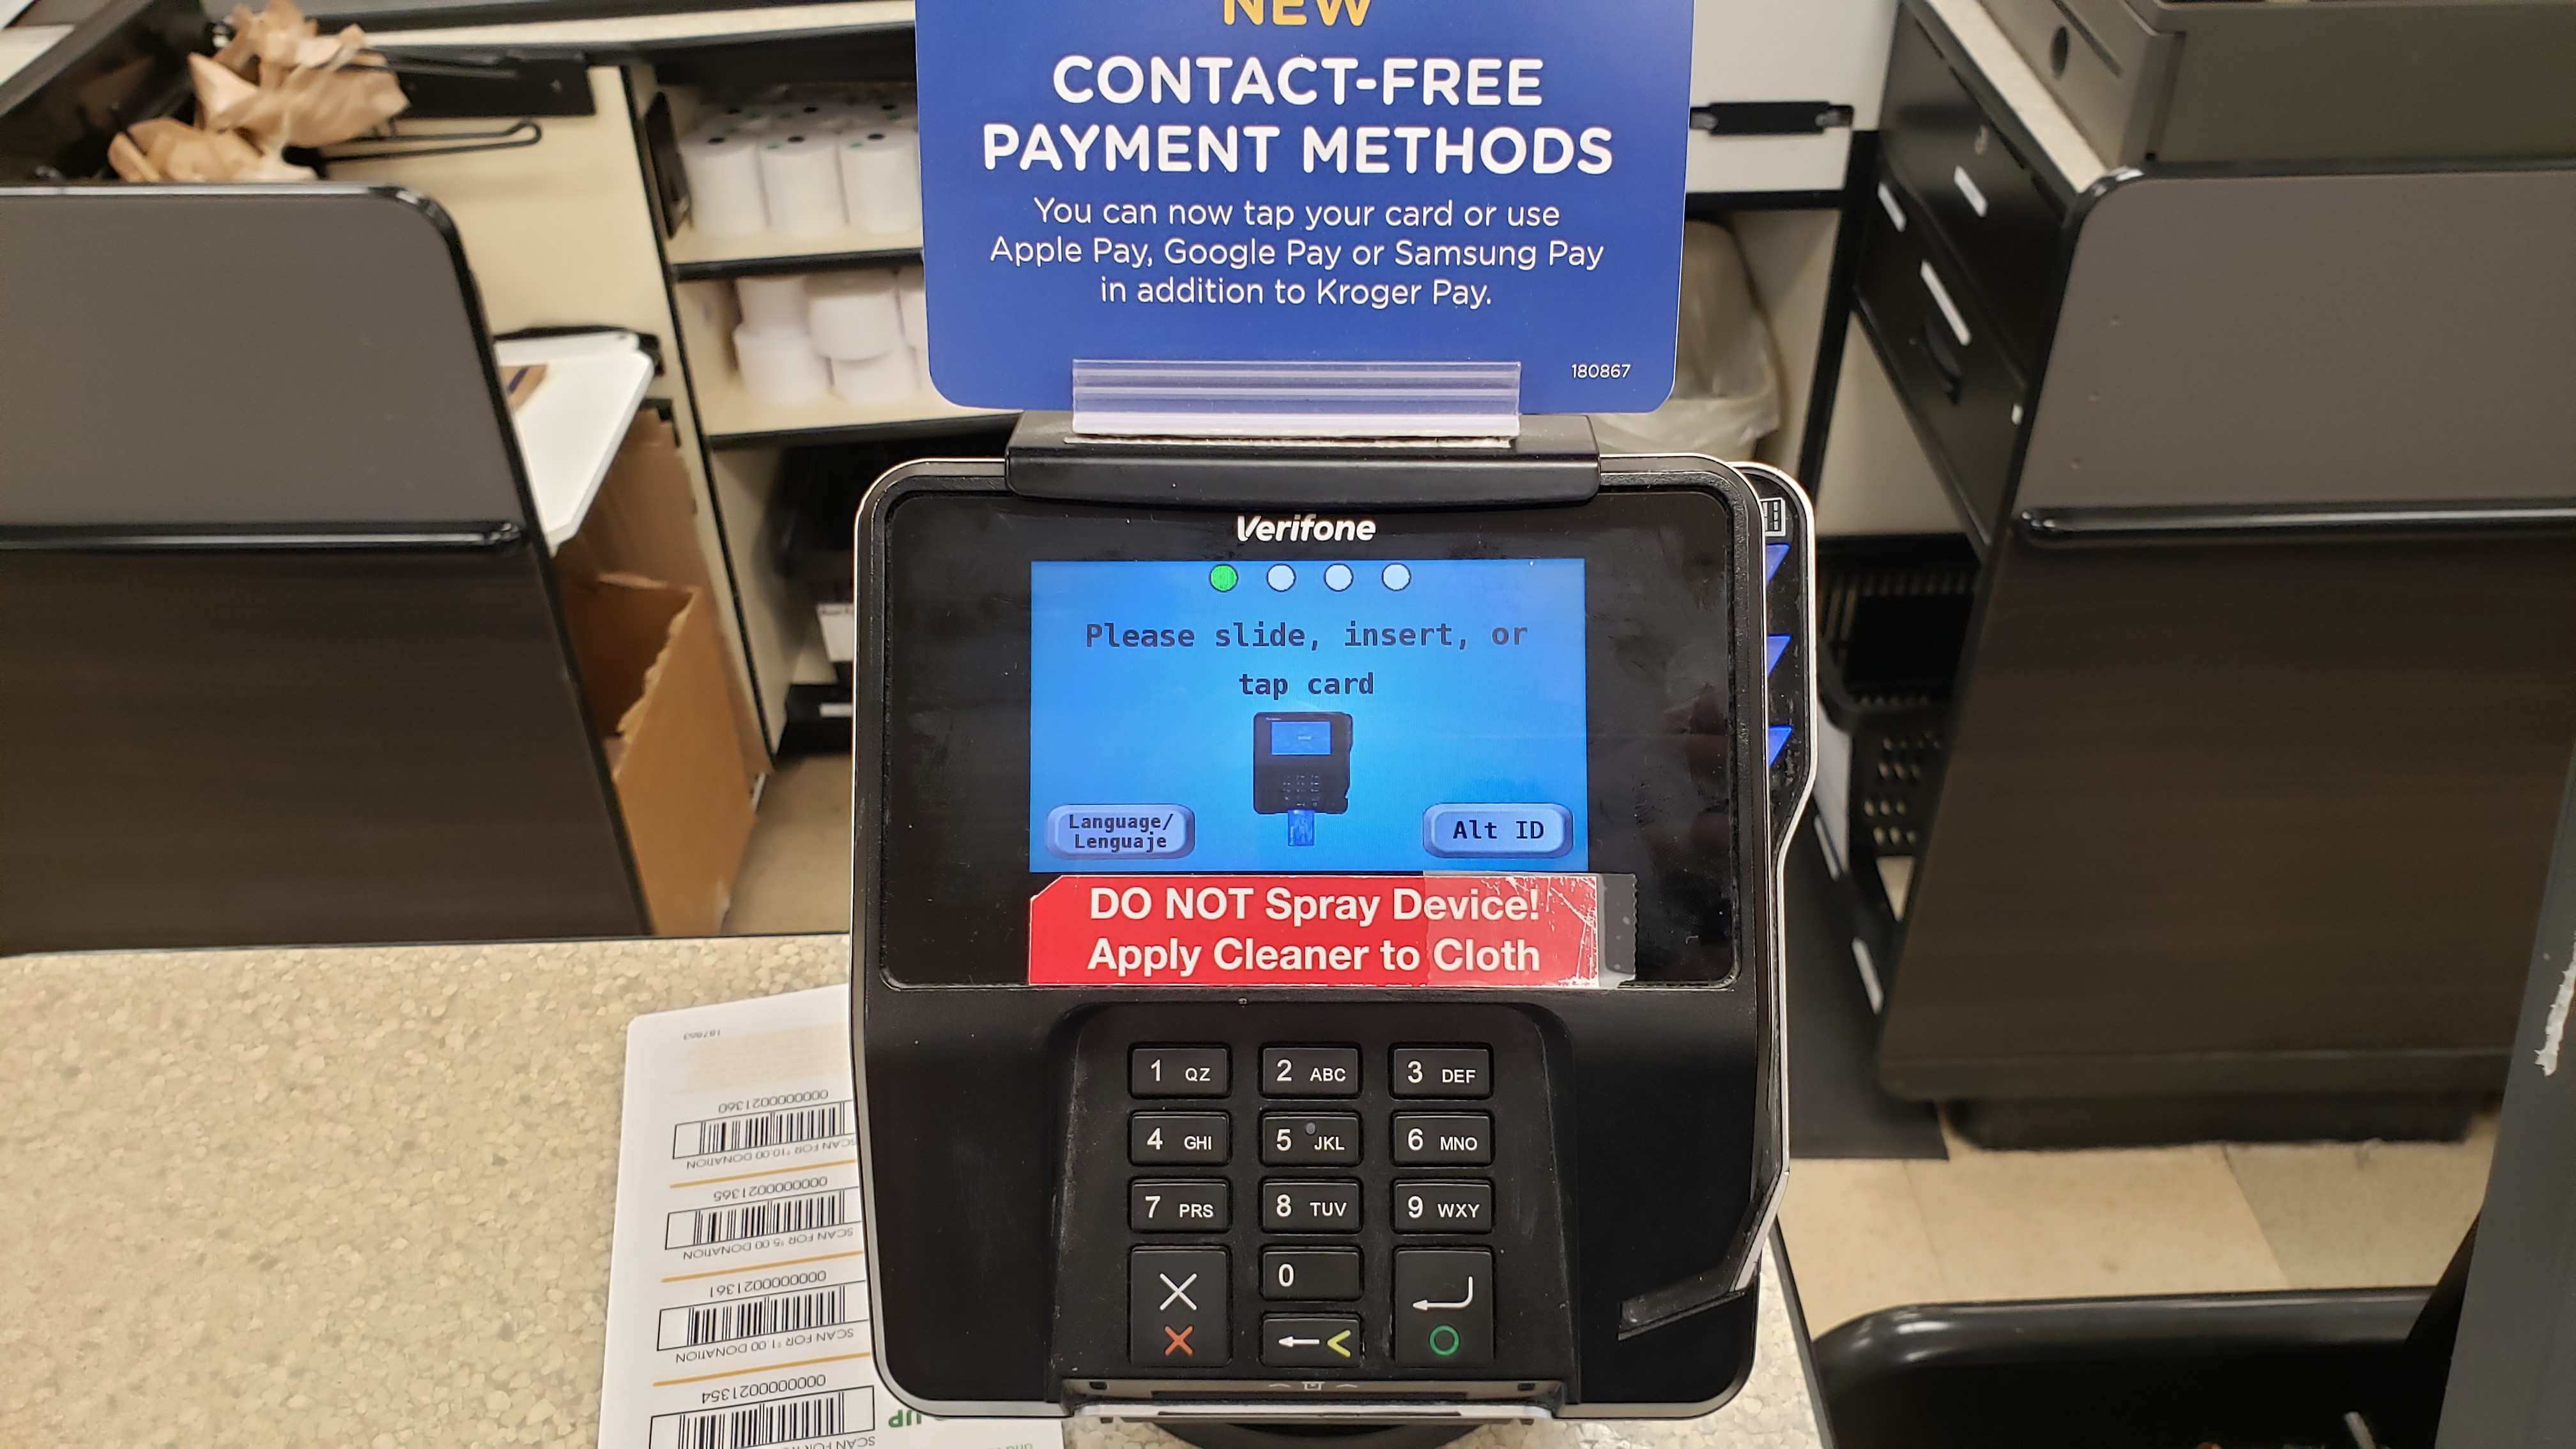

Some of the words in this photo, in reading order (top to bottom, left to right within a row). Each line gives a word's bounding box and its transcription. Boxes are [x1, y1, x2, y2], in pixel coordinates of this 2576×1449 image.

[1223, 0, 1370, 26] NEW
[1053, 55, 1544, 105] CONTACT-FREE
[983, 123, 1280, 172] PAYMENT
[1303, 126, 1613, 174] METHODS
[1034, 197, 1091, 225] You
[1103, 203, 1156, 226] can
[1169, 204, 1233, 226] now
[1244, 200, 1294, 231] tap
[1305, 206, 1375, 231] your
[1385, 199, 1453, 226] card
[1464, 206, 1497, 226] or
[1508, 206, 1560, 227] use
[990, 236, 1082, 267] Apple
[1094, 237, 1153, 268] Pay,
[1165, 238, 1275, 270] Google
[1287, 239, 1342, 270] Pay
[1353, 245, 1384, 266] or
[1395, 240, 1537, 270] Samsung
[1549, 240, 1604, 270] Pay
[1101, 275, 1126, 302] in
[1137, 276, 1263, 303] addition
[1275, 279, 1305, 304] to
[1317, 278, 1422, 309] Kroger
[1433, 279, 1491, 309] Pay.
[1571, 364, 1631, 378] 180867
[1237, 514, 1376, 542] Verifone
[1086, 622, 1195, 648] Please
[1215, 620, 1320, 651] slide,
[1344, 620, 1468, 650] insert,
[1492, 627, 1528, 645] or
[1239, 673, 1288, 700] tap
[1308, 671, 1374, 694] card
[1069, 813, 1174, 833] Language/
[1452, 819, 1498, 839] Alt
[1515, 820, 1544, 839] ID
[1074, 832, 1167, 851] Lenguaje
[1091, 887, 1152, 919] DO
[1166, 887, 1254, 920] NOT
[1265, 887, 1380, 928] Spray
[1393, 887, 1540, 921] Device!
[1087, 937, 1202, 975] Apply
[1214, 937, 1370, 970] Cleaner
[1379, 940, 1420, 970] to
[1434, 938, 1540, 970] Cloth
[1151, 1059, 1162, 1082] 1
[1185, 1068, 1211, 1082] QZ
[1276, 1059, 1292, 1082] 2
[1310, 1068, 1346, 1082] ABC
[1407, 1061, 1423, 1084] 3
[1442, 1069, 1476, 1084] DEF
[795, 1144, 819, 1154] FOR
[822, 1138, 855, 1151] SCAN
[1147, 1128, 1163, 1150] 4
[1184, 1135, 1212, 1150] GHI
[1276, 1128, 1292, 1151] 5
[1314, 1136, 1345, 1151] JKL
[1407, 1128, 1423, 1151] 6
[1440, 1136, 1478, 1151] MNO
[686, 1153, 752, 1169] DONATION
[1145, 1195, 1161, 1218] 7
[1179, 1204, 1214, 1218] PRS
[1276, 1194, 1292, 1217] 8
[1310, 1202, 1347, 1217] TUV
[1408, 1195, 1423, 1218] 9
[1438, 1203, 1480, 1218] WXY
[788, 1234, 814, 1245] FOR
[818, 1227, 854, 1241] SCAN
[683, 1243, 751, 1261] DONATION
[1278, 1264, 1294, 1287] 0
[786, 1334, 813, 1347] FOR
[816, 1328, 854, 1342] SCAN
[675, 1344, 747, 1363] DONATION
[836, 1436, 876, 1449] SCAN
